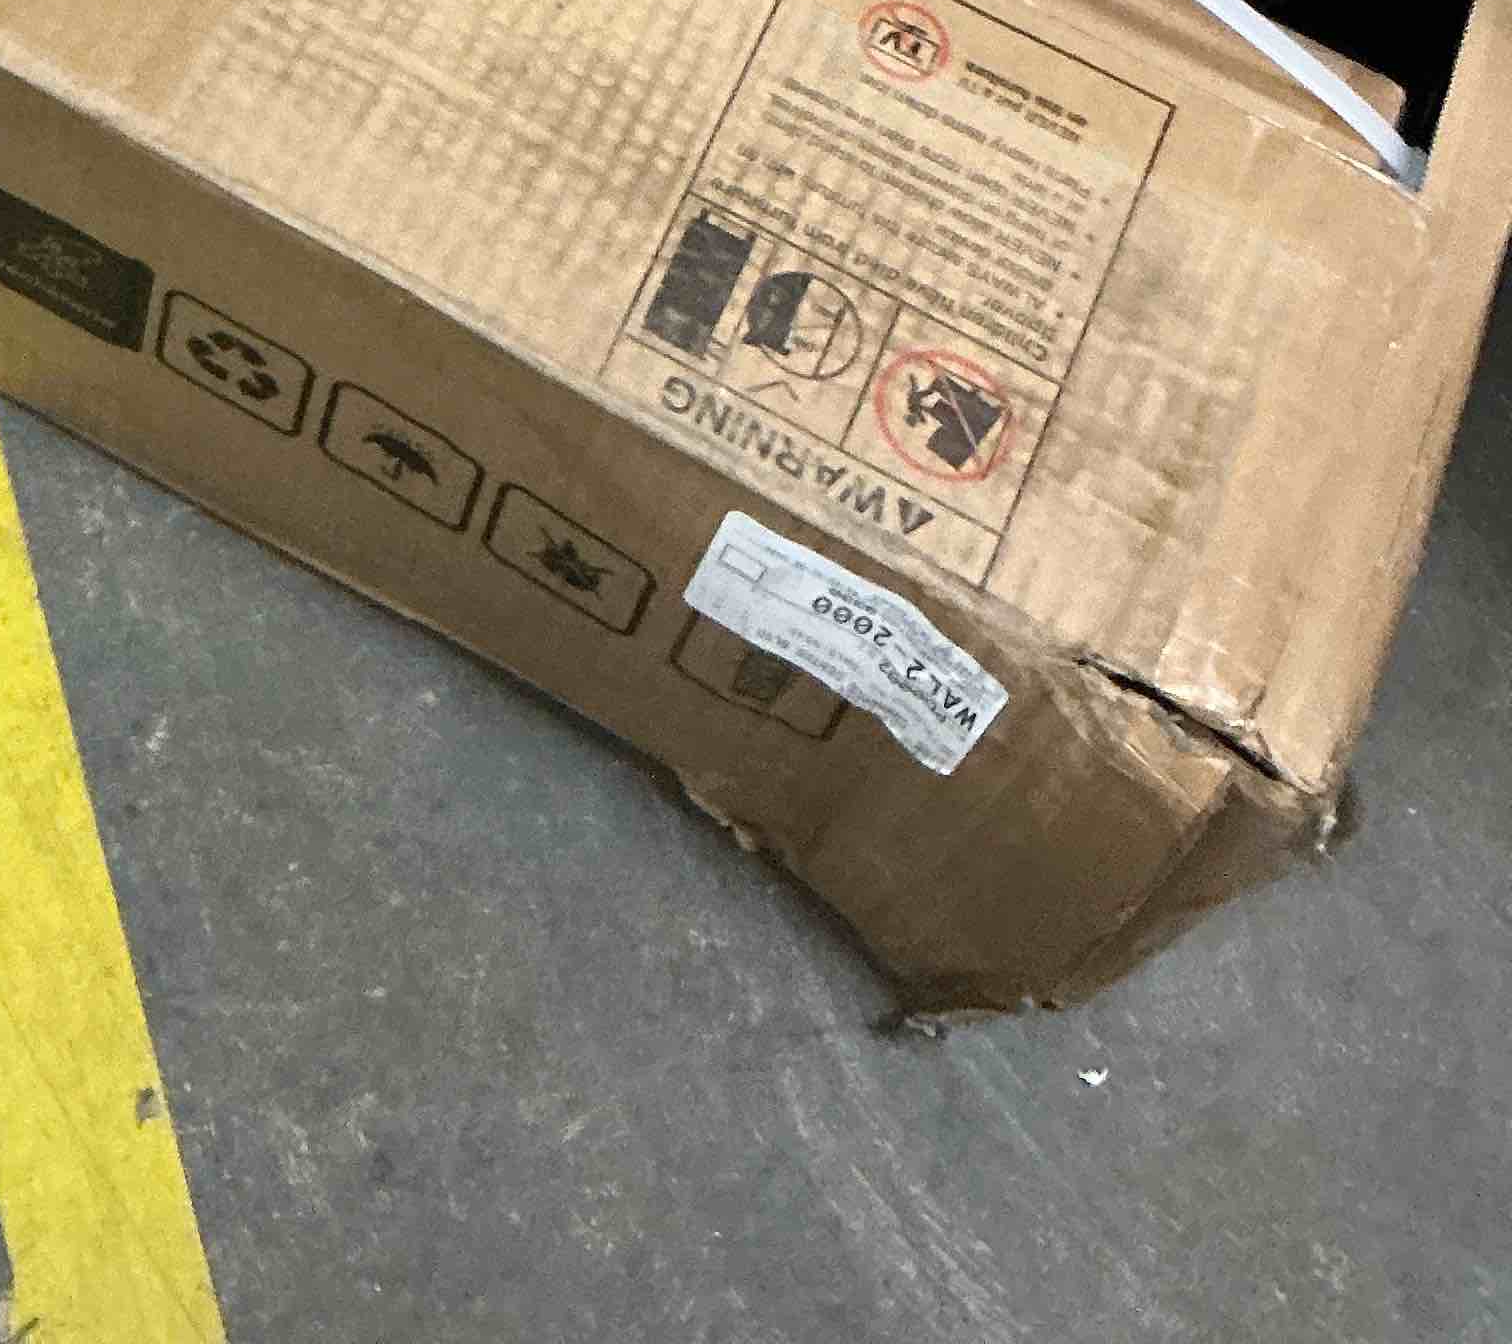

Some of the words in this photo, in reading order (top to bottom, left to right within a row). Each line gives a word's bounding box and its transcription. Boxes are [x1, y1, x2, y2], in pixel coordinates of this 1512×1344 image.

[870, 214, 900, 235] this
[1012, 193, 1077, 234] NEVER
[803, 225, 849, 256] from
[906, 231, 960, 265] secure
[995, 229, 1061, 271] NEVER
[853, 251, 899, 283] died
[903, 277, 955, 313] have
[965, 263, 1043, 310] ALWAYS
[957, 304, 1048, 361] Children
[662, 376, 886, 523] WARNING
